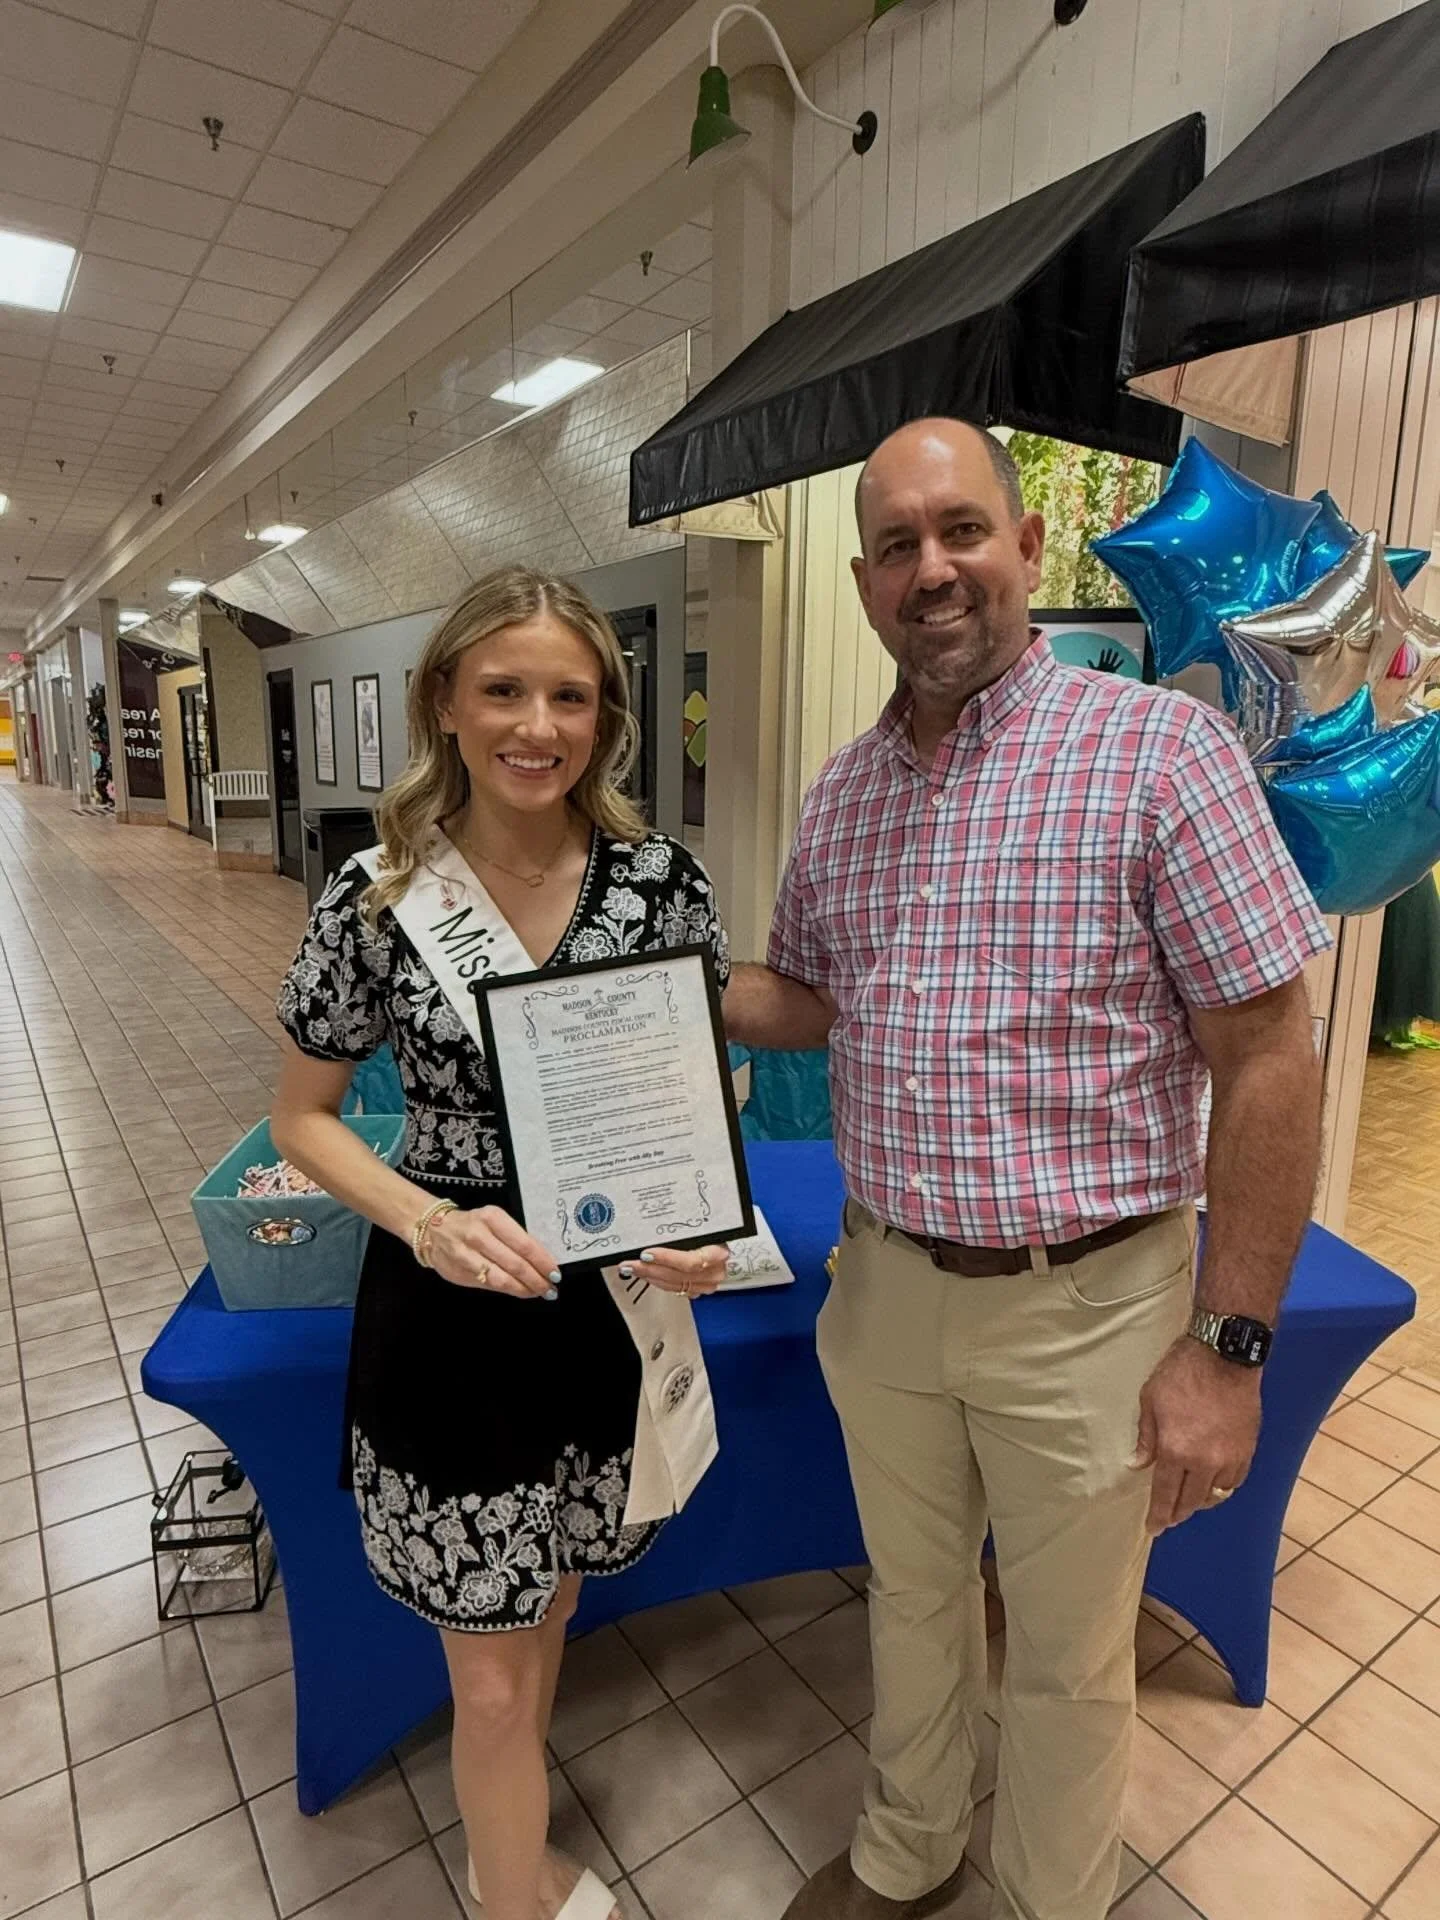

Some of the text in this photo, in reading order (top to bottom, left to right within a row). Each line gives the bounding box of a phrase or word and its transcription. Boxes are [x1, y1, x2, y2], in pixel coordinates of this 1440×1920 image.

[562, 991, 637, 1011] MADISON COUNTY
[585, 1008, 618, 1021] KENTUCKY
[563, 1021, 647, 1044] PROCLAMATION
